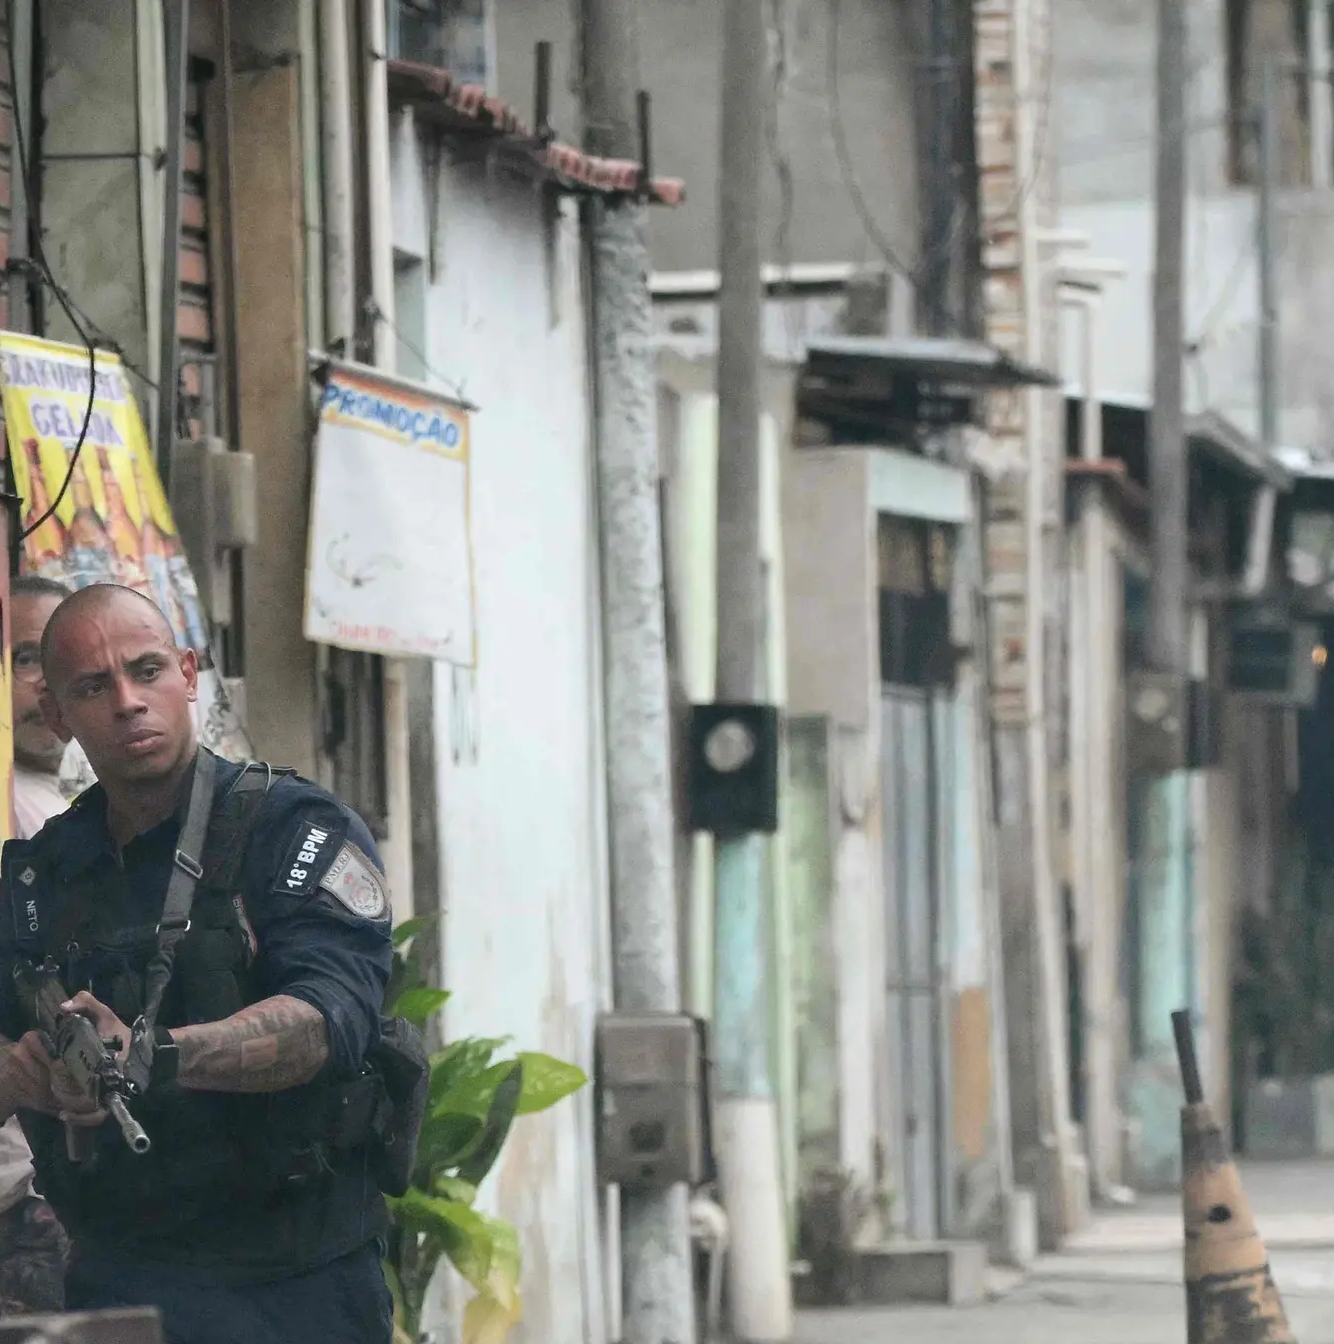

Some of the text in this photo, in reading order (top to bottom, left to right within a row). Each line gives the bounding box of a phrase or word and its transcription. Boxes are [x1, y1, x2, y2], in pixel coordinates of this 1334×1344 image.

[320, 384, 459, 448] PROMOÇÃO
[297, 828, 328, 864] BPM
[325, 851, 350, 884] PMERJ
[25, 899, 39, 932] NETO
